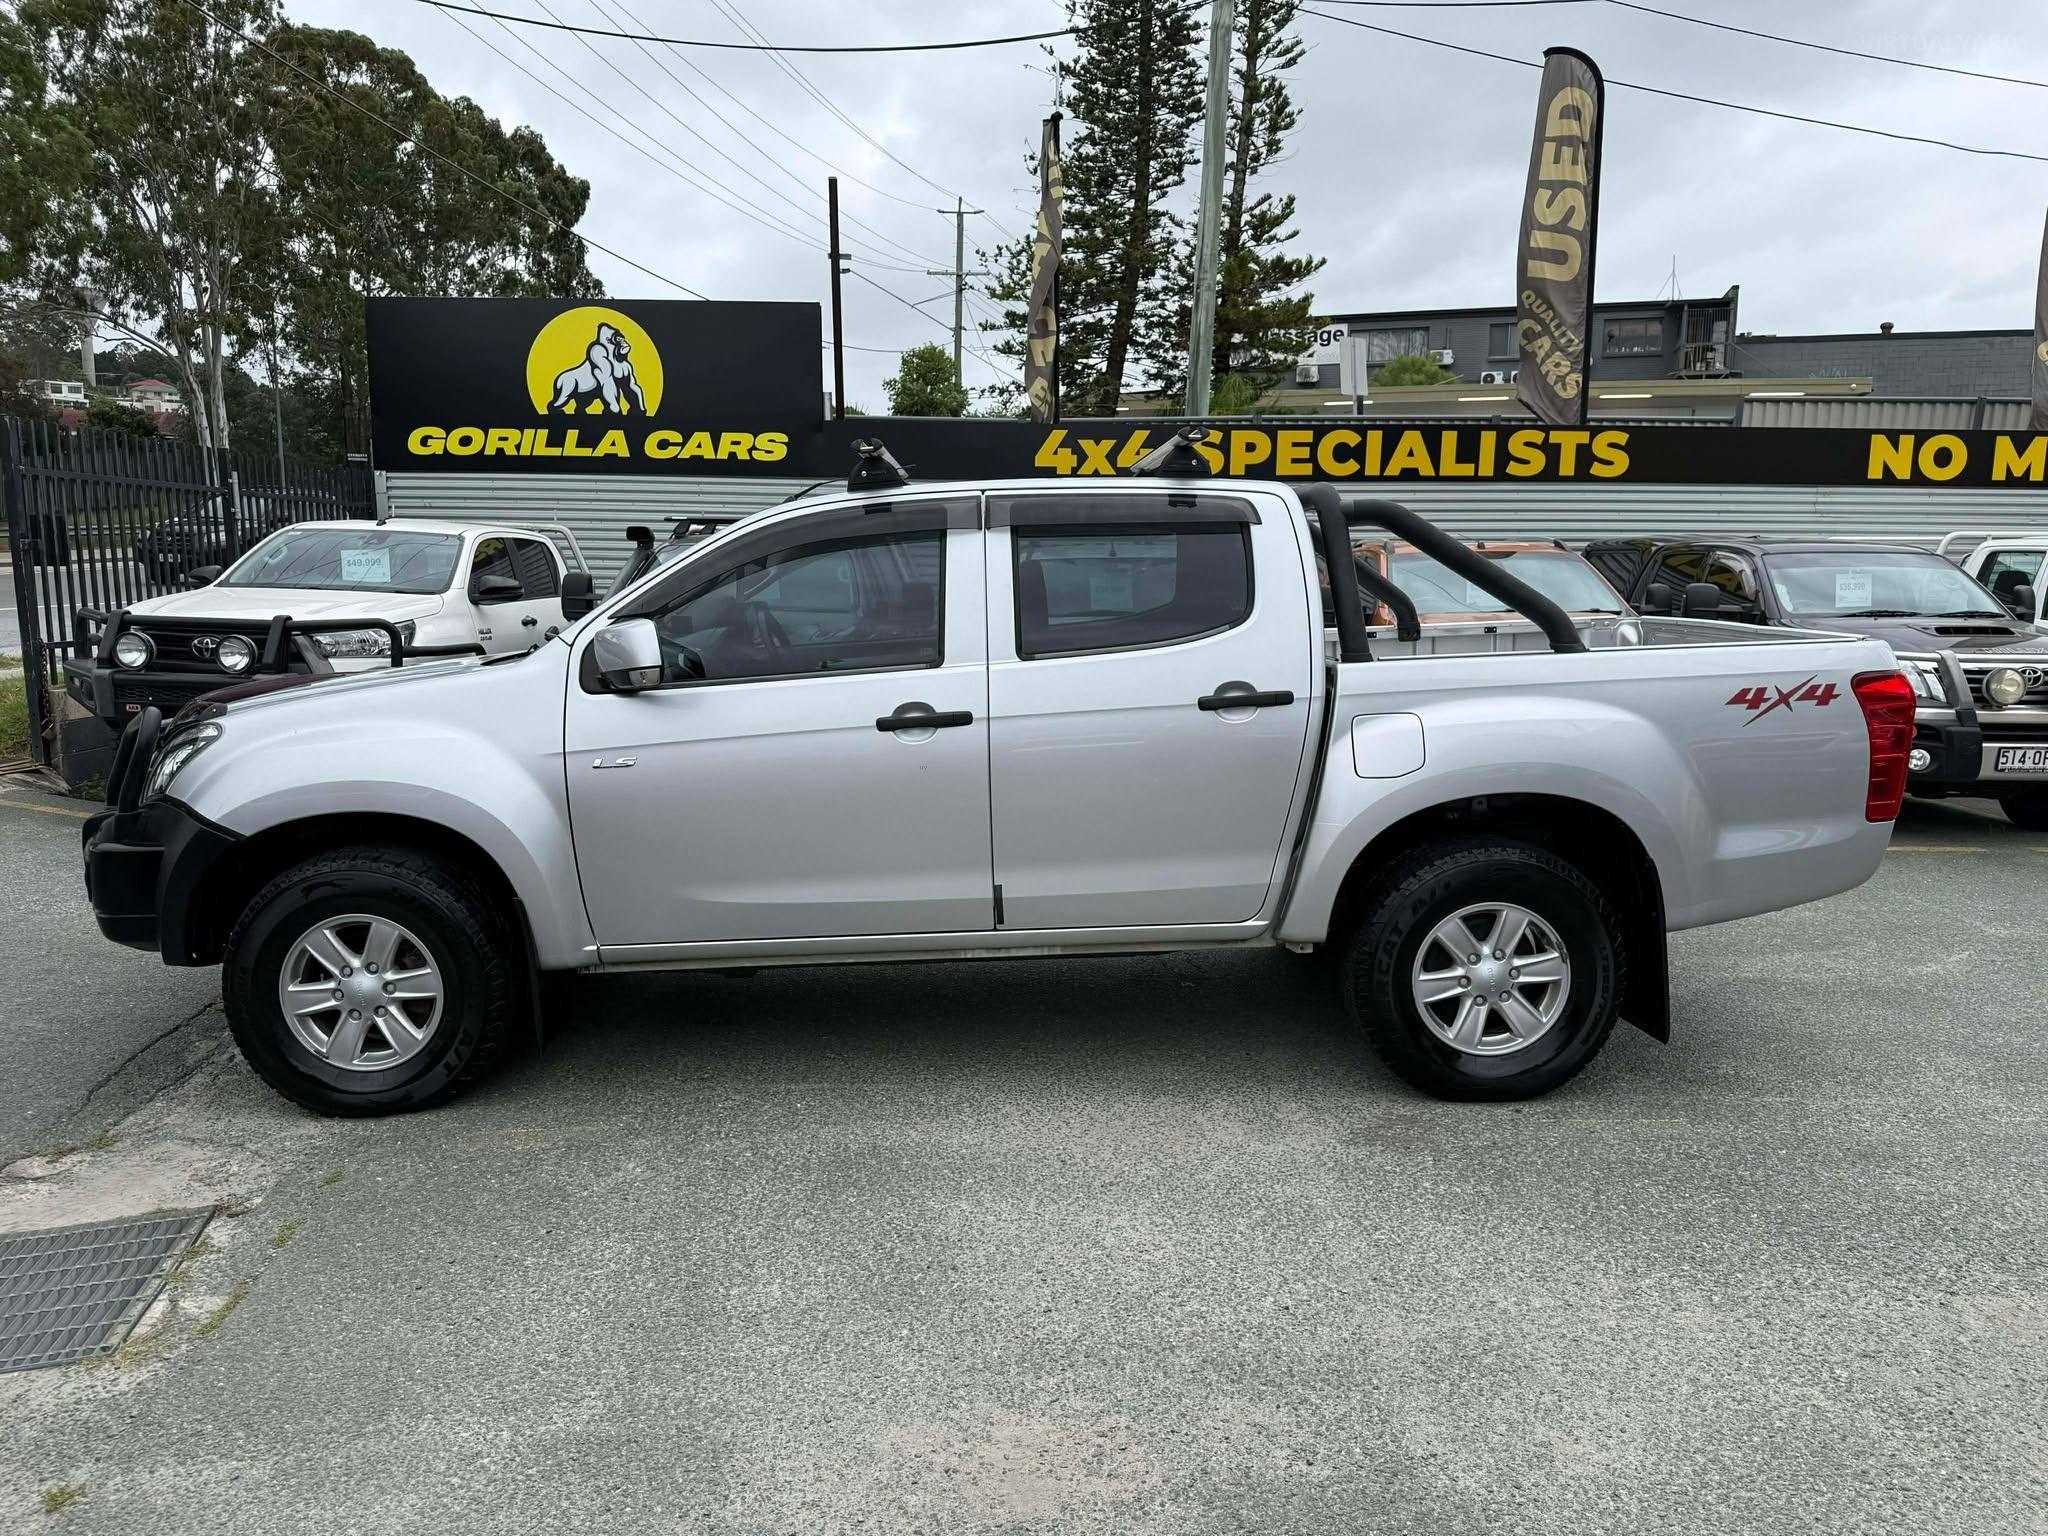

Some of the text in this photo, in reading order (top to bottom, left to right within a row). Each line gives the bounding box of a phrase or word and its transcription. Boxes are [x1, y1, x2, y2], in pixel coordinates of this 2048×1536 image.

[1527, 86, 1594, 282] USED
[1521, 289, 1584, 351] QUALITY
[1517, 317, 1583, 400] CARS
[407, 426, 788, 462] GORILLA CARS
[1192, 429, 1630, 478] SPECIALISTS
[1867, 434, 2048, 482] NO M
